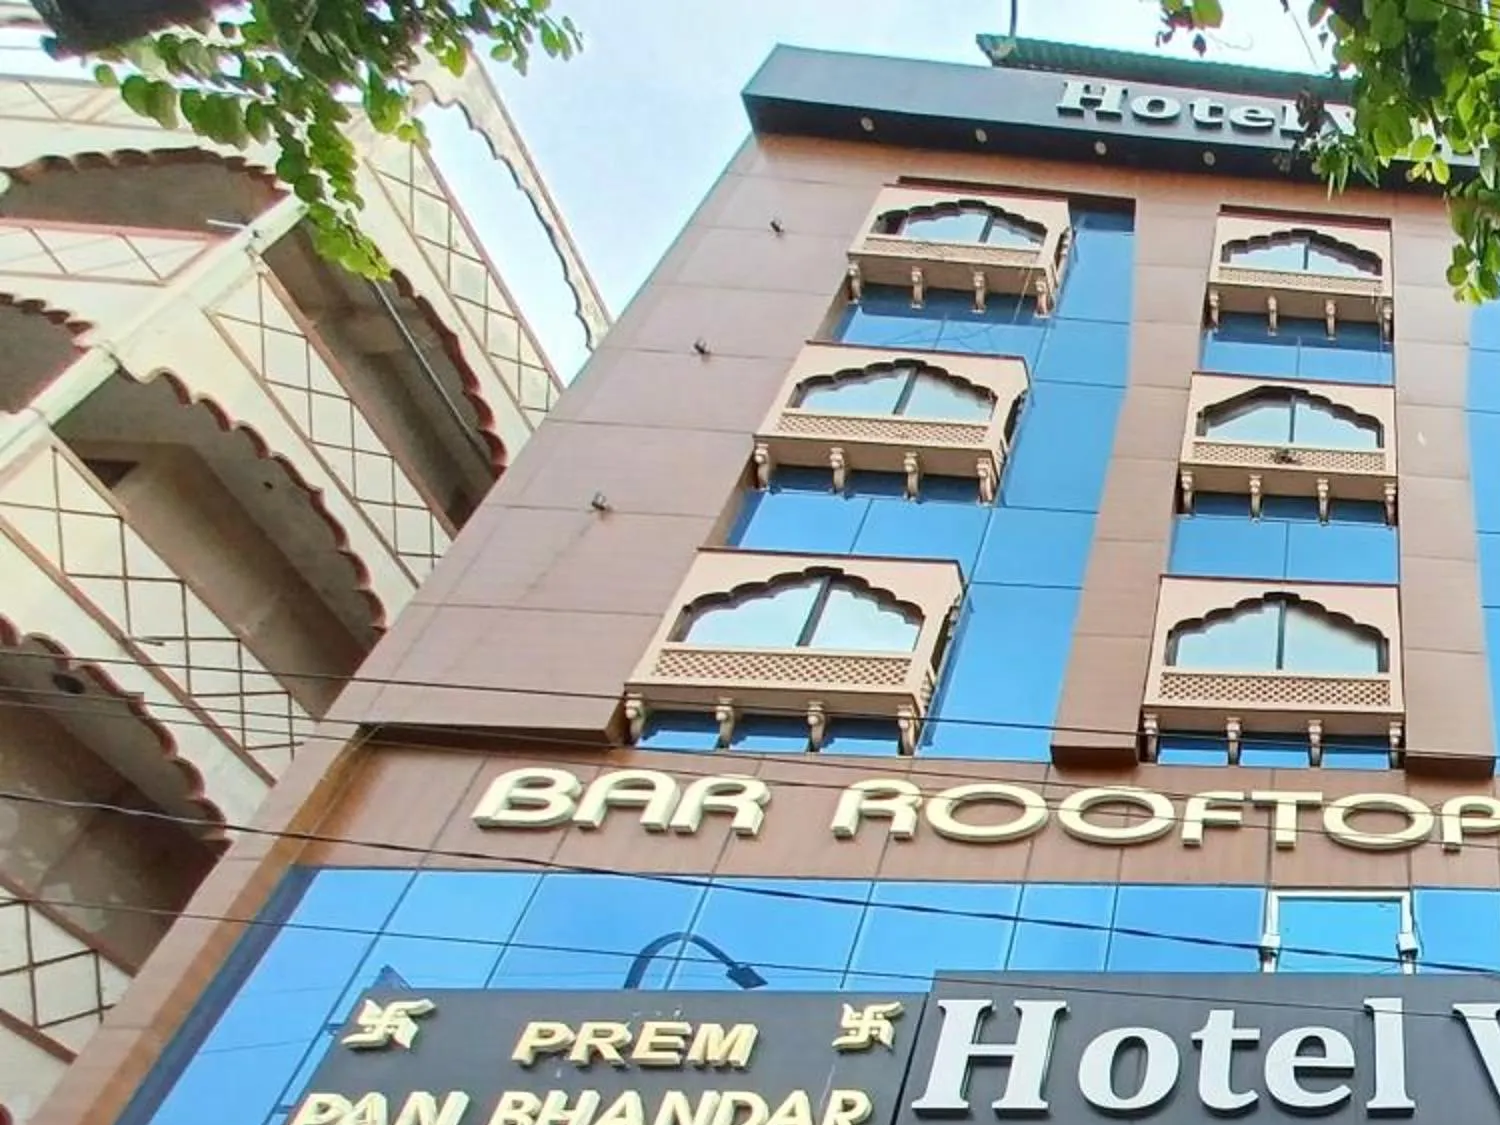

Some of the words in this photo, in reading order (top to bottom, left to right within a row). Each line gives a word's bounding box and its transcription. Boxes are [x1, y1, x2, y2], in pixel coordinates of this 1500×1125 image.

[1055, 79, 1312, 134] Hotel
[471, 767, 772, 838] BAR
[510, 1020, 759, 1071] PREM
[911, 996, 1417, 1118] Hotel
